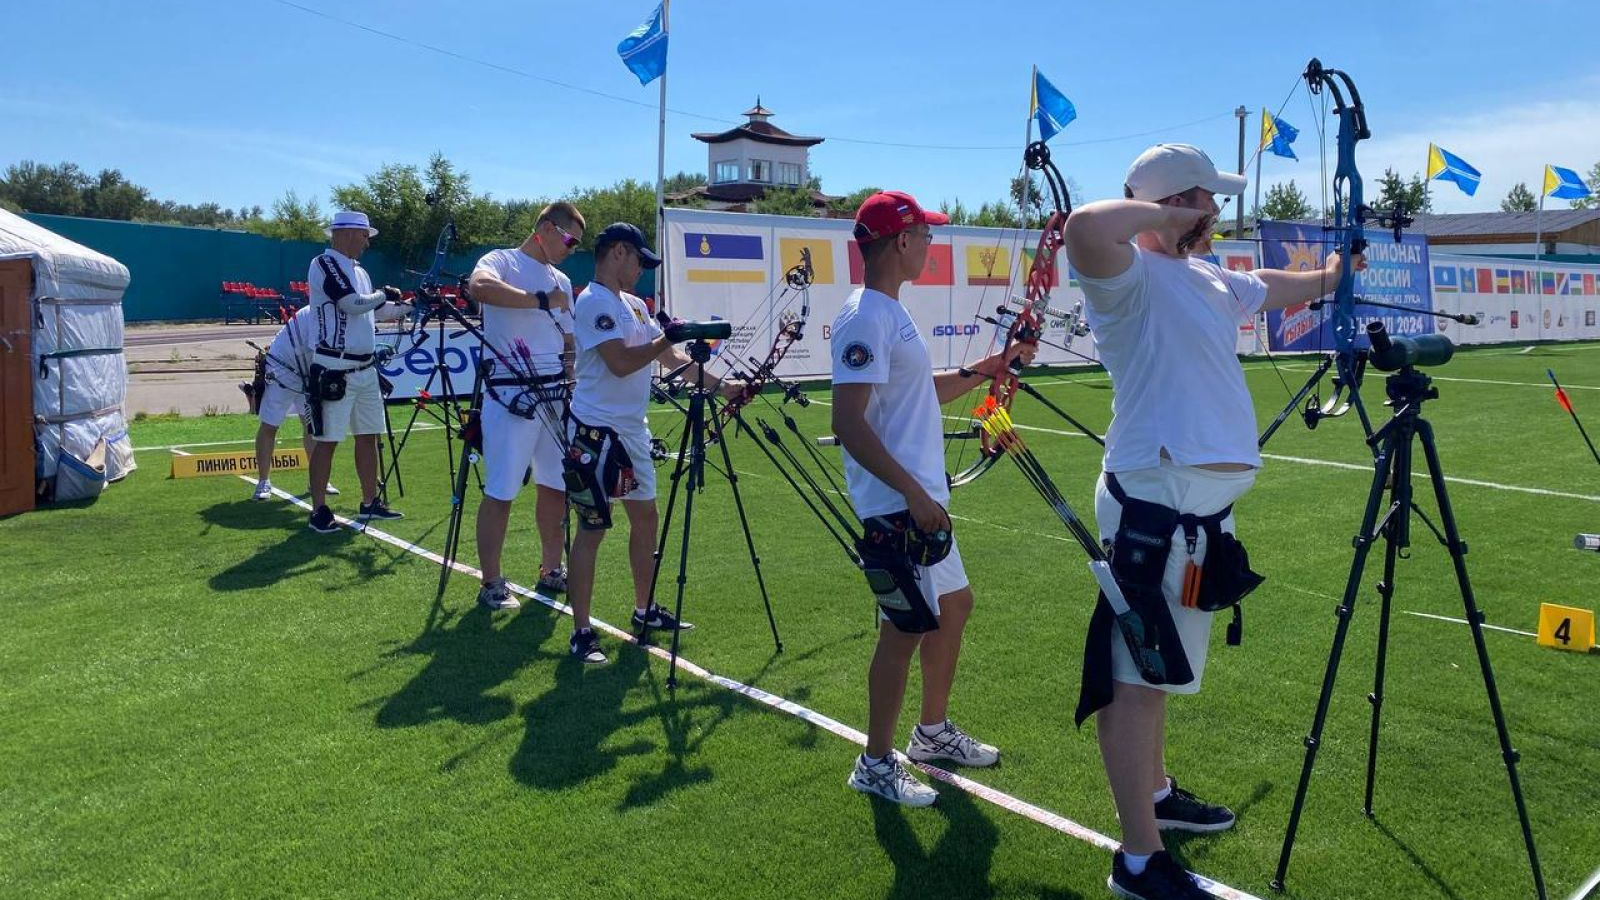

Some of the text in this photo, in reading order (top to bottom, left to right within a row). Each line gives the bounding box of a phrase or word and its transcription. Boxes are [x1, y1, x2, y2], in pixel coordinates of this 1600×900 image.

[1361, 268, 1411, 288] РОССИИ
[1397, 315, 1423, 334] 2024
[196, 457, 236, 473] ЛИНИЯ
[1555, 618, 1571, 645] 4
